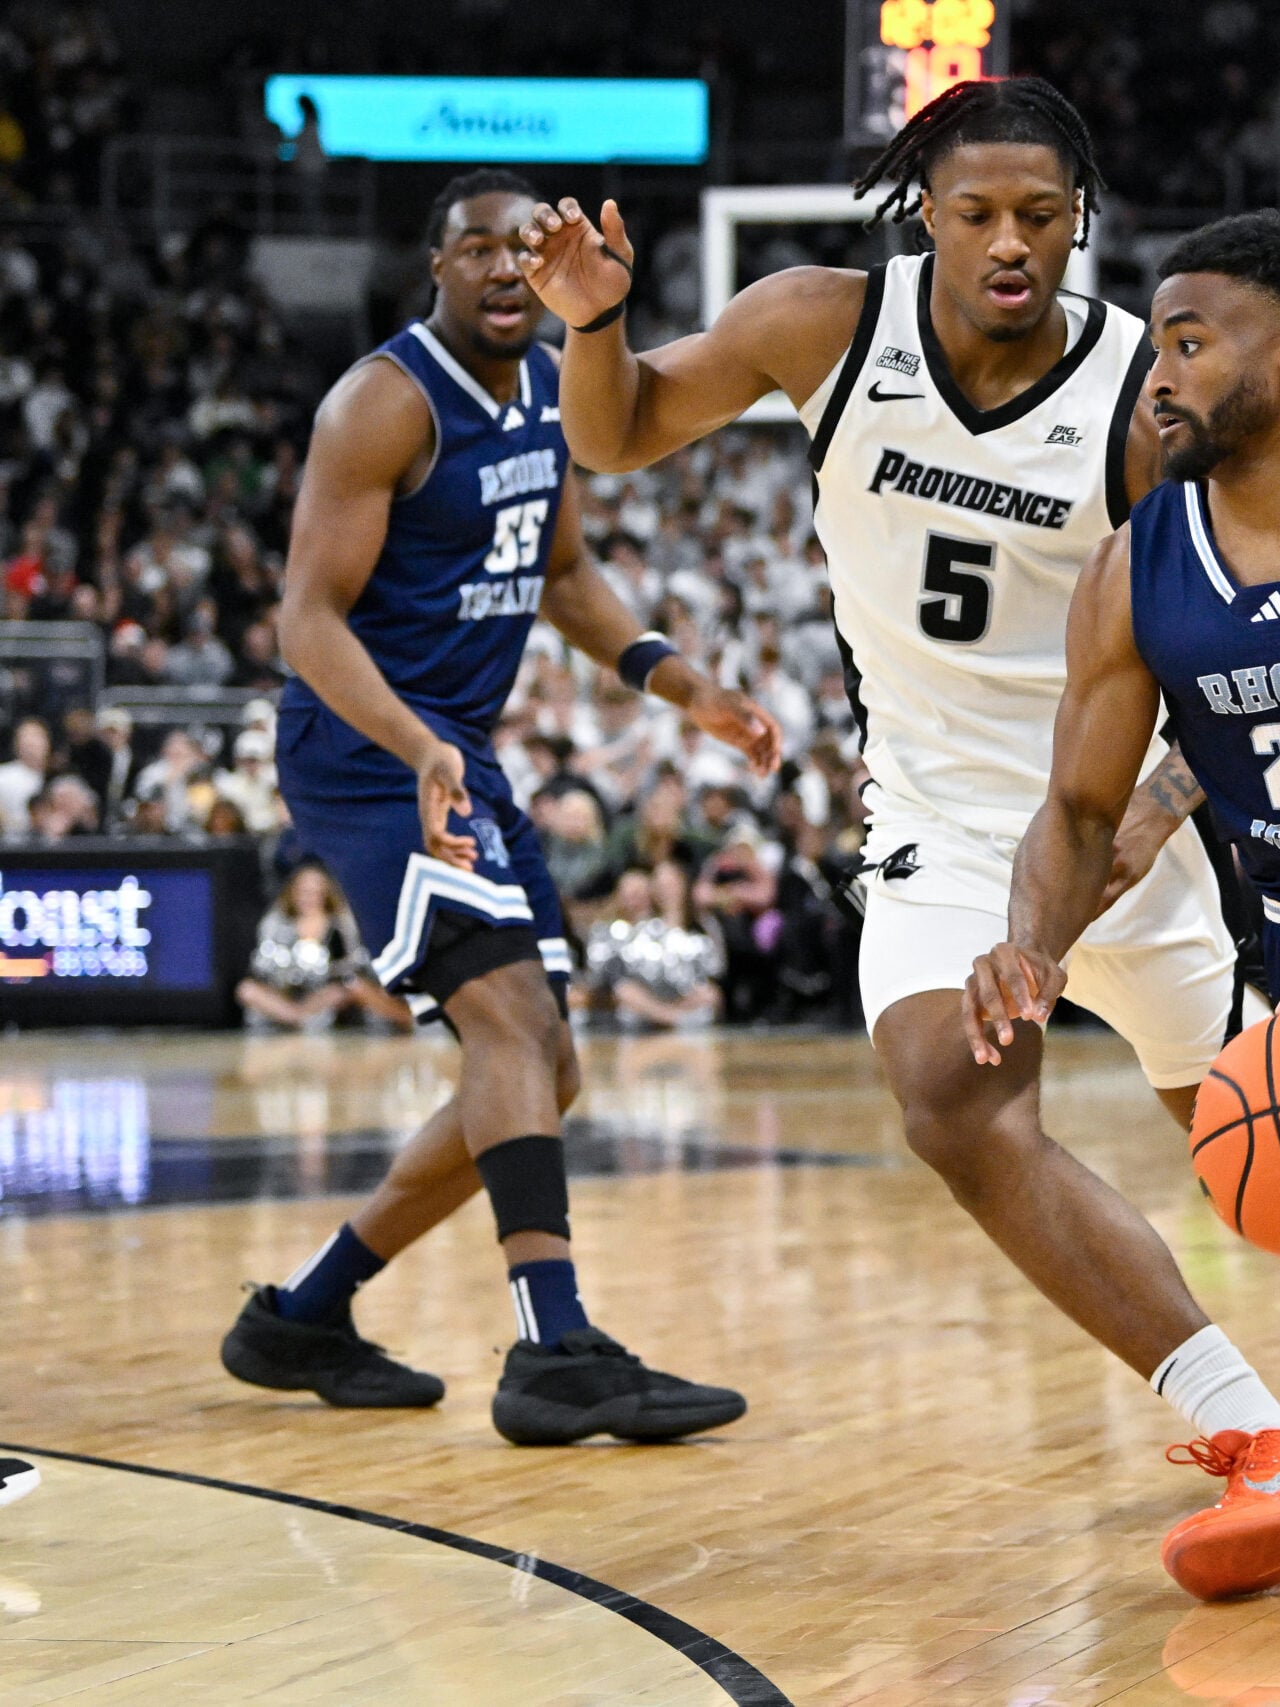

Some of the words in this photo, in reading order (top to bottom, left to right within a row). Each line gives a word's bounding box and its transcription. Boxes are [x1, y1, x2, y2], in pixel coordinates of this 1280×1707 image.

[877, 356, 917, 375] CHANGE
[883, 348, 898, 359] BE
[900, 352, 919, 366] THE
[1047, 432, 1083, 445] EAST
[1052, 425, 1077, 436] BIG
[483, 499, 549, 574] 55
[917, 529, 998, 645] 5
[0, 873, 152, 947] oast
